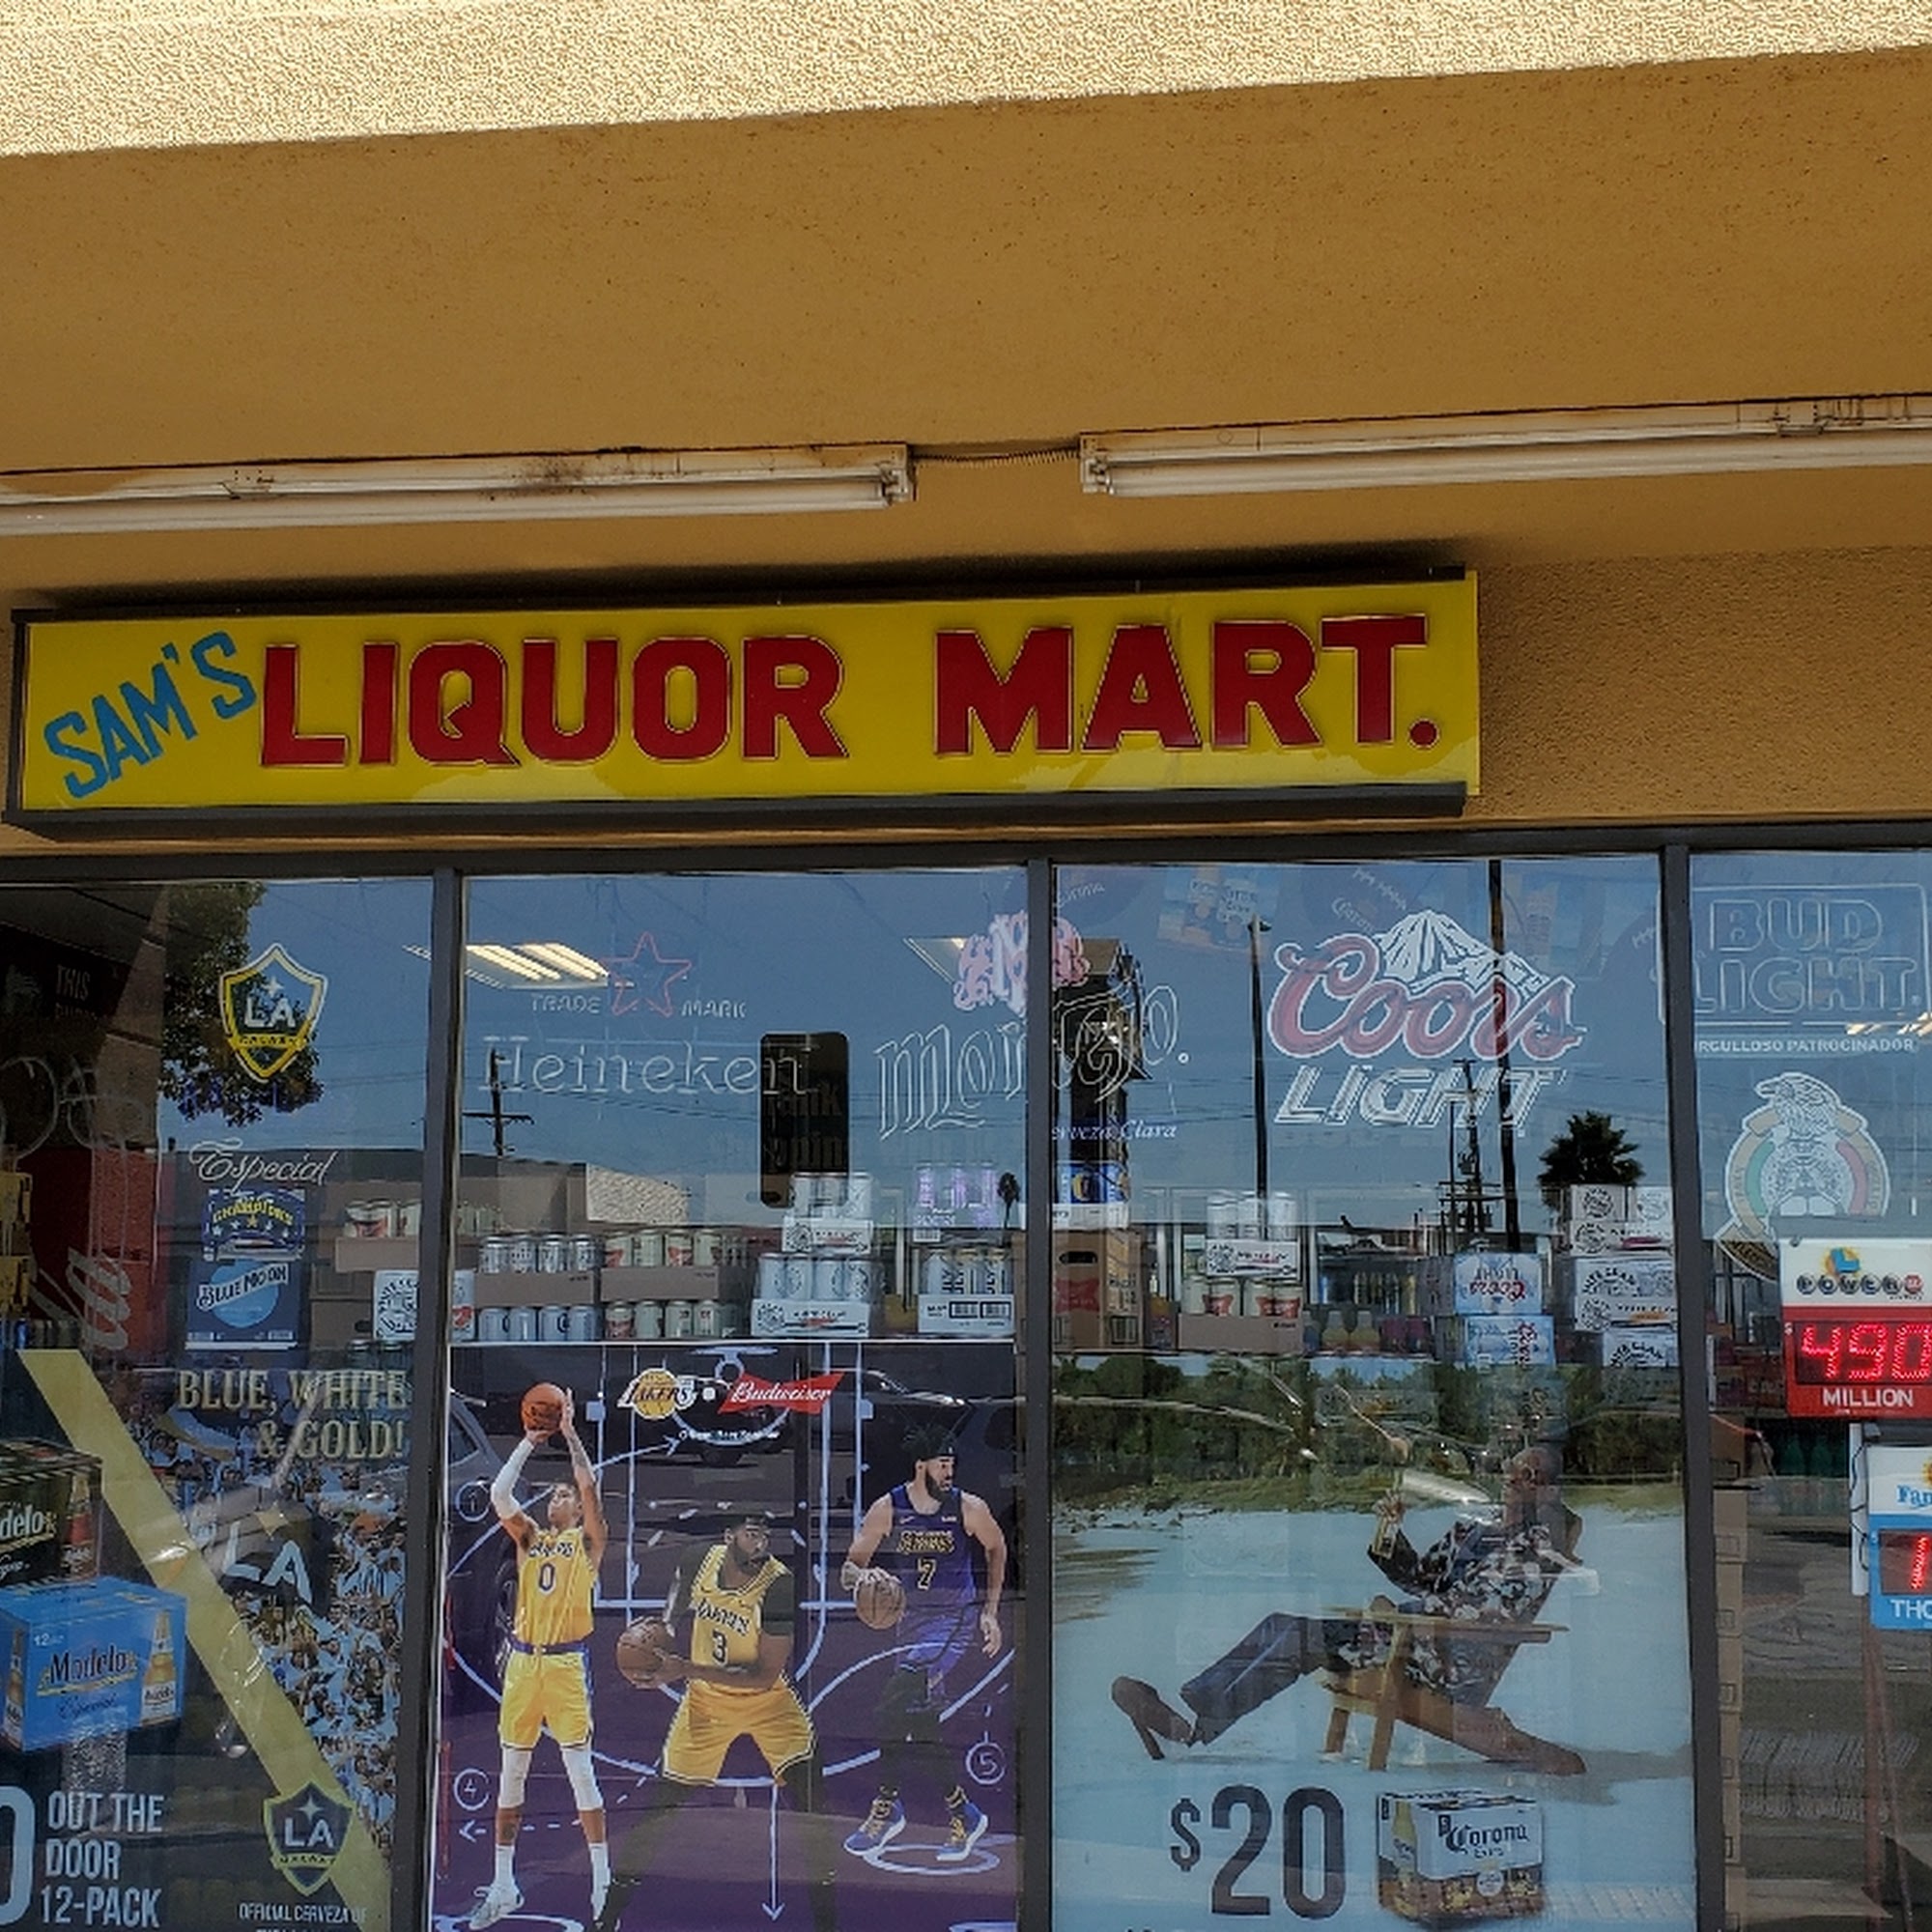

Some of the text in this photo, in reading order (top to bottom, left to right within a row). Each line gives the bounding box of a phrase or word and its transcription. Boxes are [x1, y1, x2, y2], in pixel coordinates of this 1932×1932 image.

[43, 613, 1440, 799] SAM'S LIQUOR MART.
[1710, 898, 1883, 952] BUD
[531, 994, 747, 1018] TRADE MARK
[1268, 932, 1587, 1061] Coors
[1693, 956, 1918, 1014] LIGHT
[244, 996, 296, 1027] LA
[479, 1036, 813, 1096] Heineken
[1695, 1037, 1915, 1053] RGULLOSO PATROCINADOR
[1274, 1064, 1568, 1129] LIGHT
[1051, 1119, 1178, 1141] erveza Clara
[189, 1137, 339, 1196] Especial
[1802, 1323, 1932, 1380] 490
[179, 1369, 409, 1415] BLUE, WHITE
[731, 1380, 833, 1404] Budweiser
[1823, 1388, 1915, 1407] MILLION
[256, 1420, 404, 1459] & GOLD!
[222, 1520, 312, 1605] LA
[538, 1562, 557, 1595] 0
[917, 1557, 937, 1591] 7
[49, 1643, 128, 1685] Modelo
[711, 1629, 727, 1663] 3
[48, 1791, 165, 1833] OUT THE
[284, 1817, 334, 1848] LA
[45, 1838, 121, 1881] DOOR
[1170, 1783, 1347, 1920] $20
[1445, 1824, 1530, 1856] Corona
[40, 1885, 163, 1928] 12-PACK
[294, 1904, 350, 1924] CERVEZA
